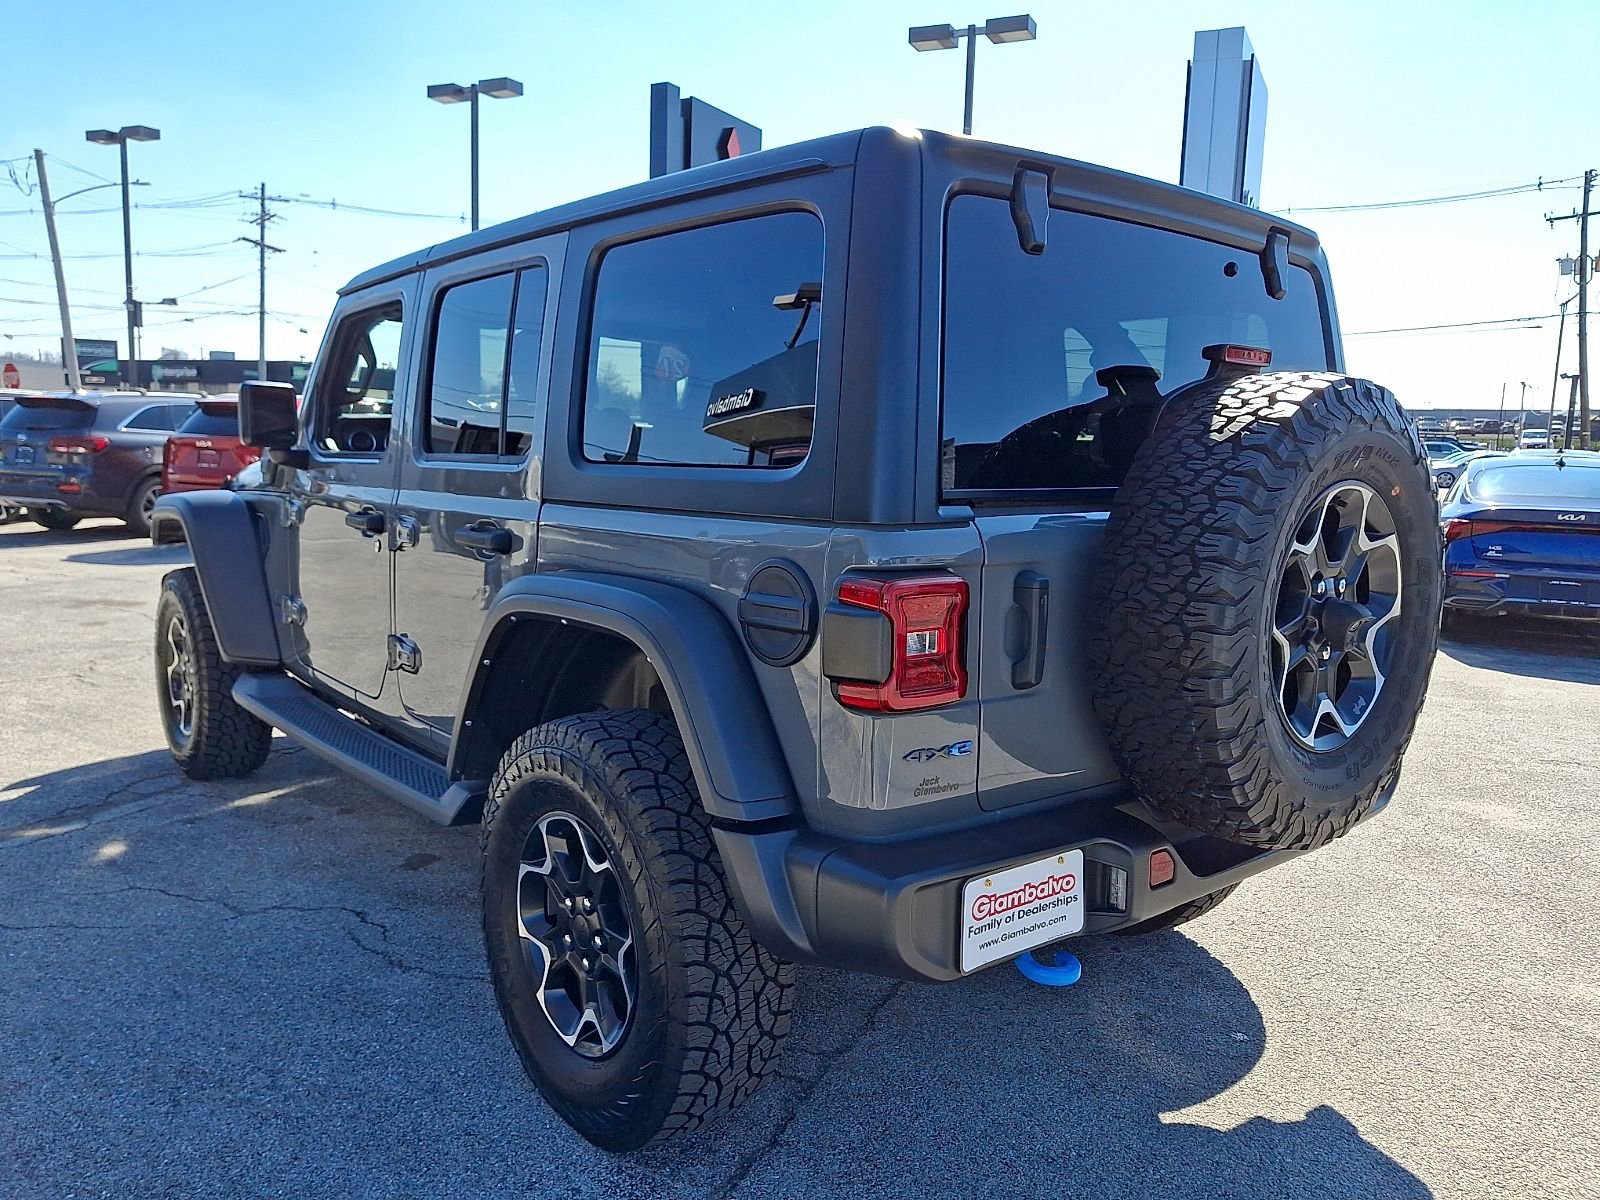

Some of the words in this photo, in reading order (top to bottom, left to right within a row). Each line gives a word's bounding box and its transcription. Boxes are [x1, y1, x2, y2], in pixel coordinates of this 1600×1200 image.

[913, 782, 960, 798] Giambalvo
[920, 775, 941, 788] Jack
[971, 873, 1076, 922] Giambalvo
[967, 918, 1003, 939] Family
[1004, 911, 1016, 924] of
[1017, 894, 1079, 920] Dealerships
[978, 914, 1067, 951] www.Giambalvo.com
